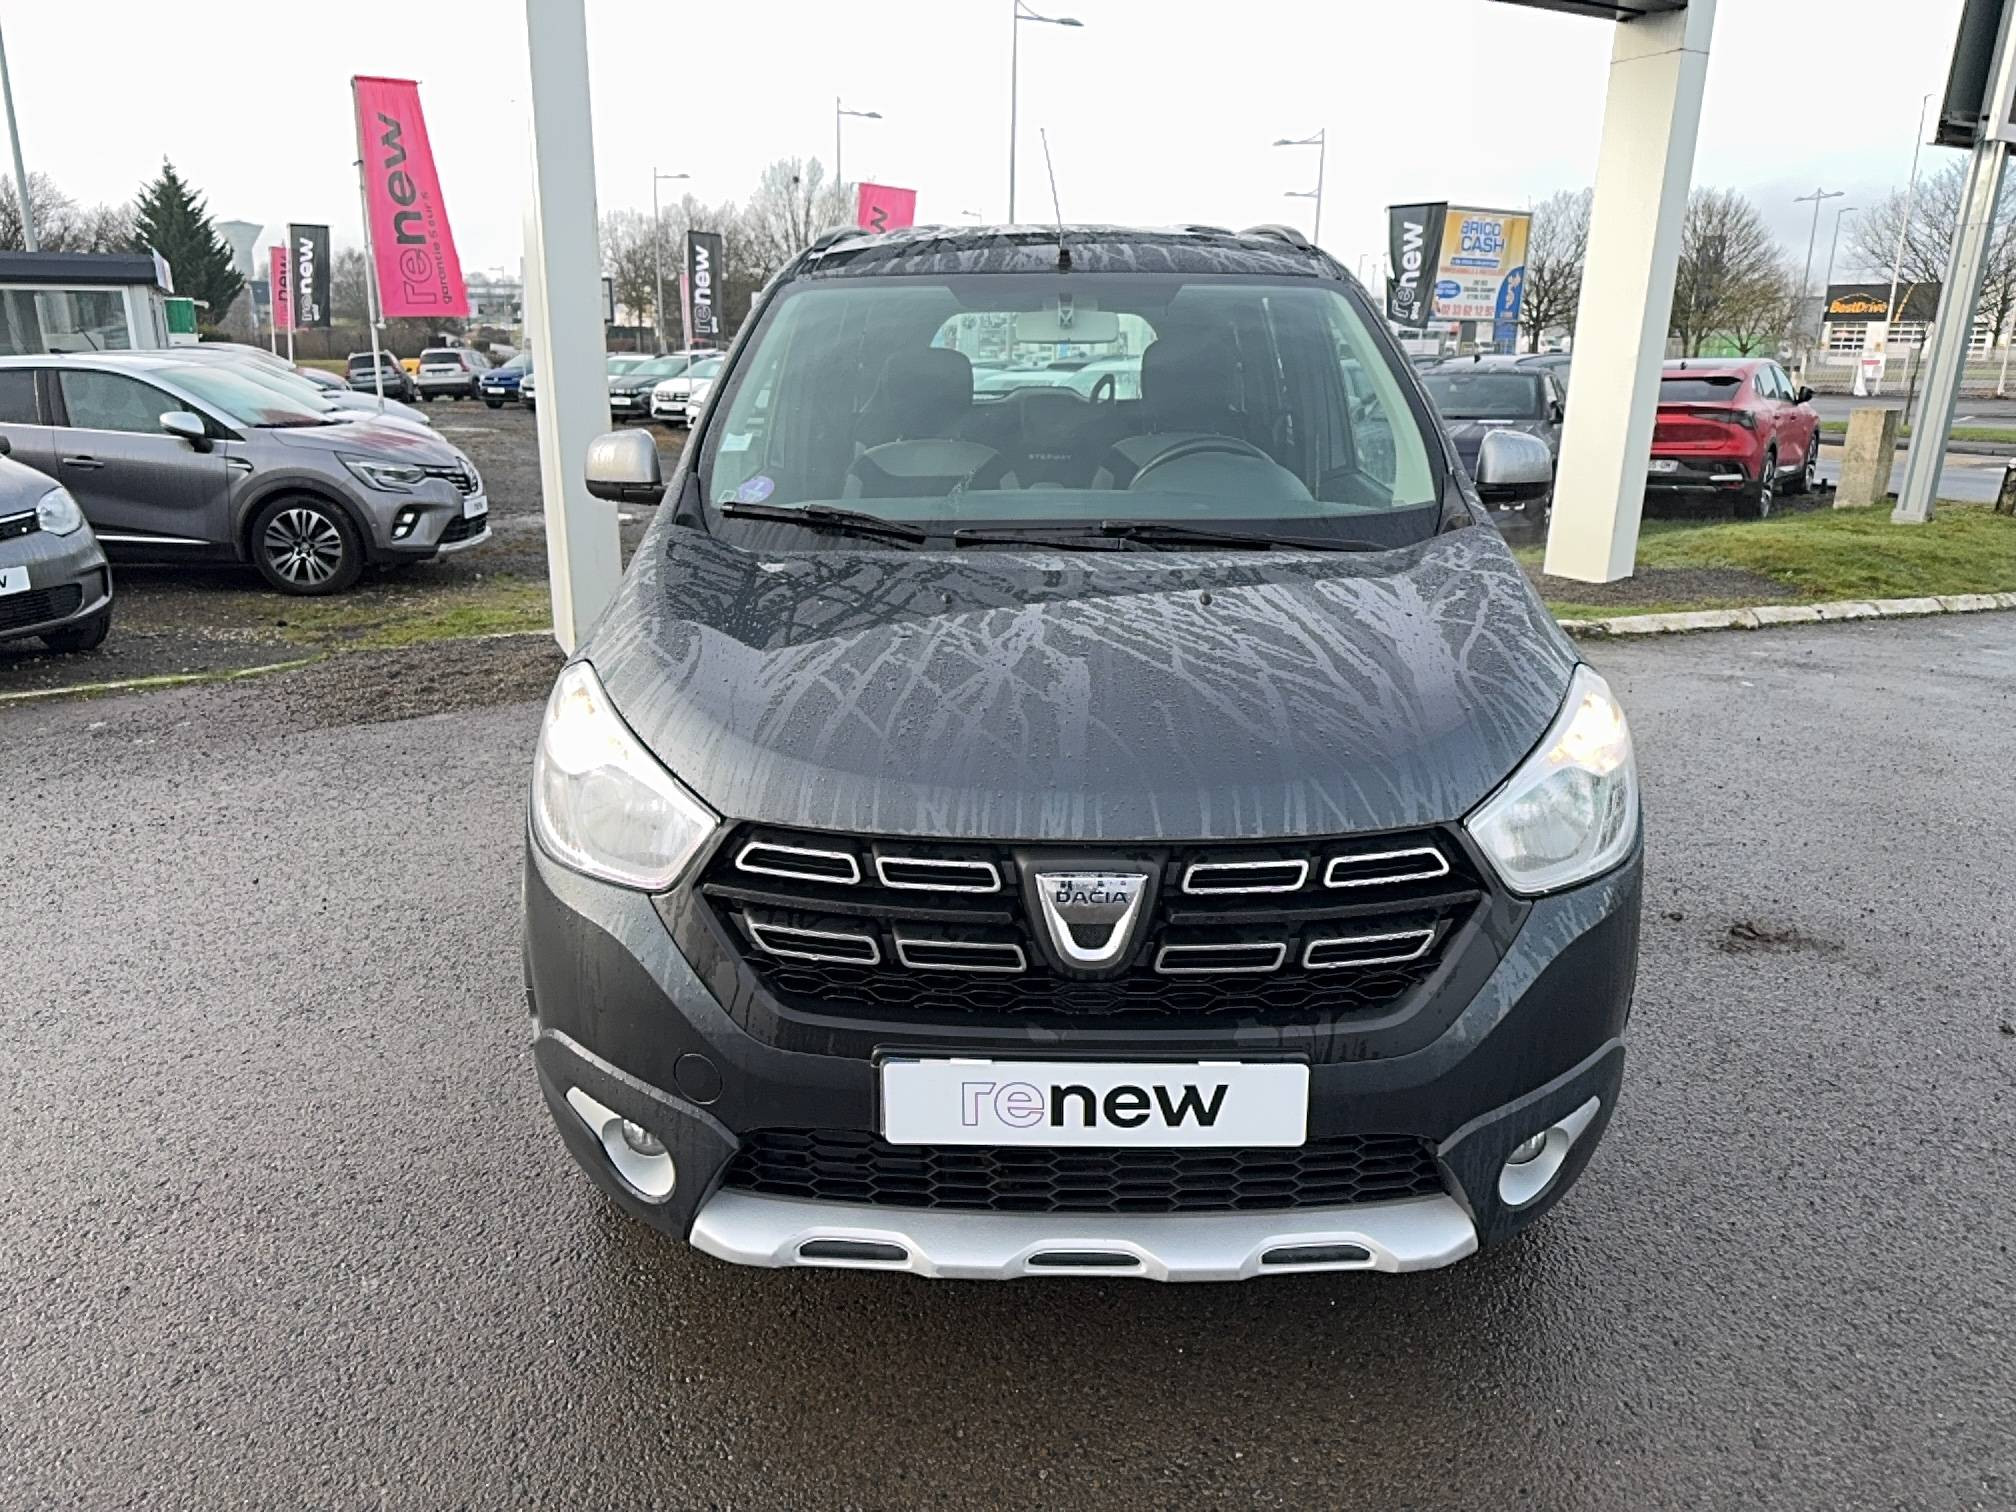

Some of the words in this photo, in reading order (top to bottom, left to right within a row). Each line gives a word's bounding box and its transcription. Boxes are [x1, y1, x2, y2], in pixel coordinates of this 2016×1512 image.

[378, 112, 437, 304] renew
[1460, 220, 1502, 237] BRICO
[1461, 236, 1505, 253] CASH
[300, 237, 313, 321] renew
[694, 245, 711, 333] renew
[1392, 221, 1423, 319] renew
[1829, 302, 1888, 313] BestDrive
[1056, 891, 1127, 904] DACIA
[962, 1082, 1229, 1128] renew
